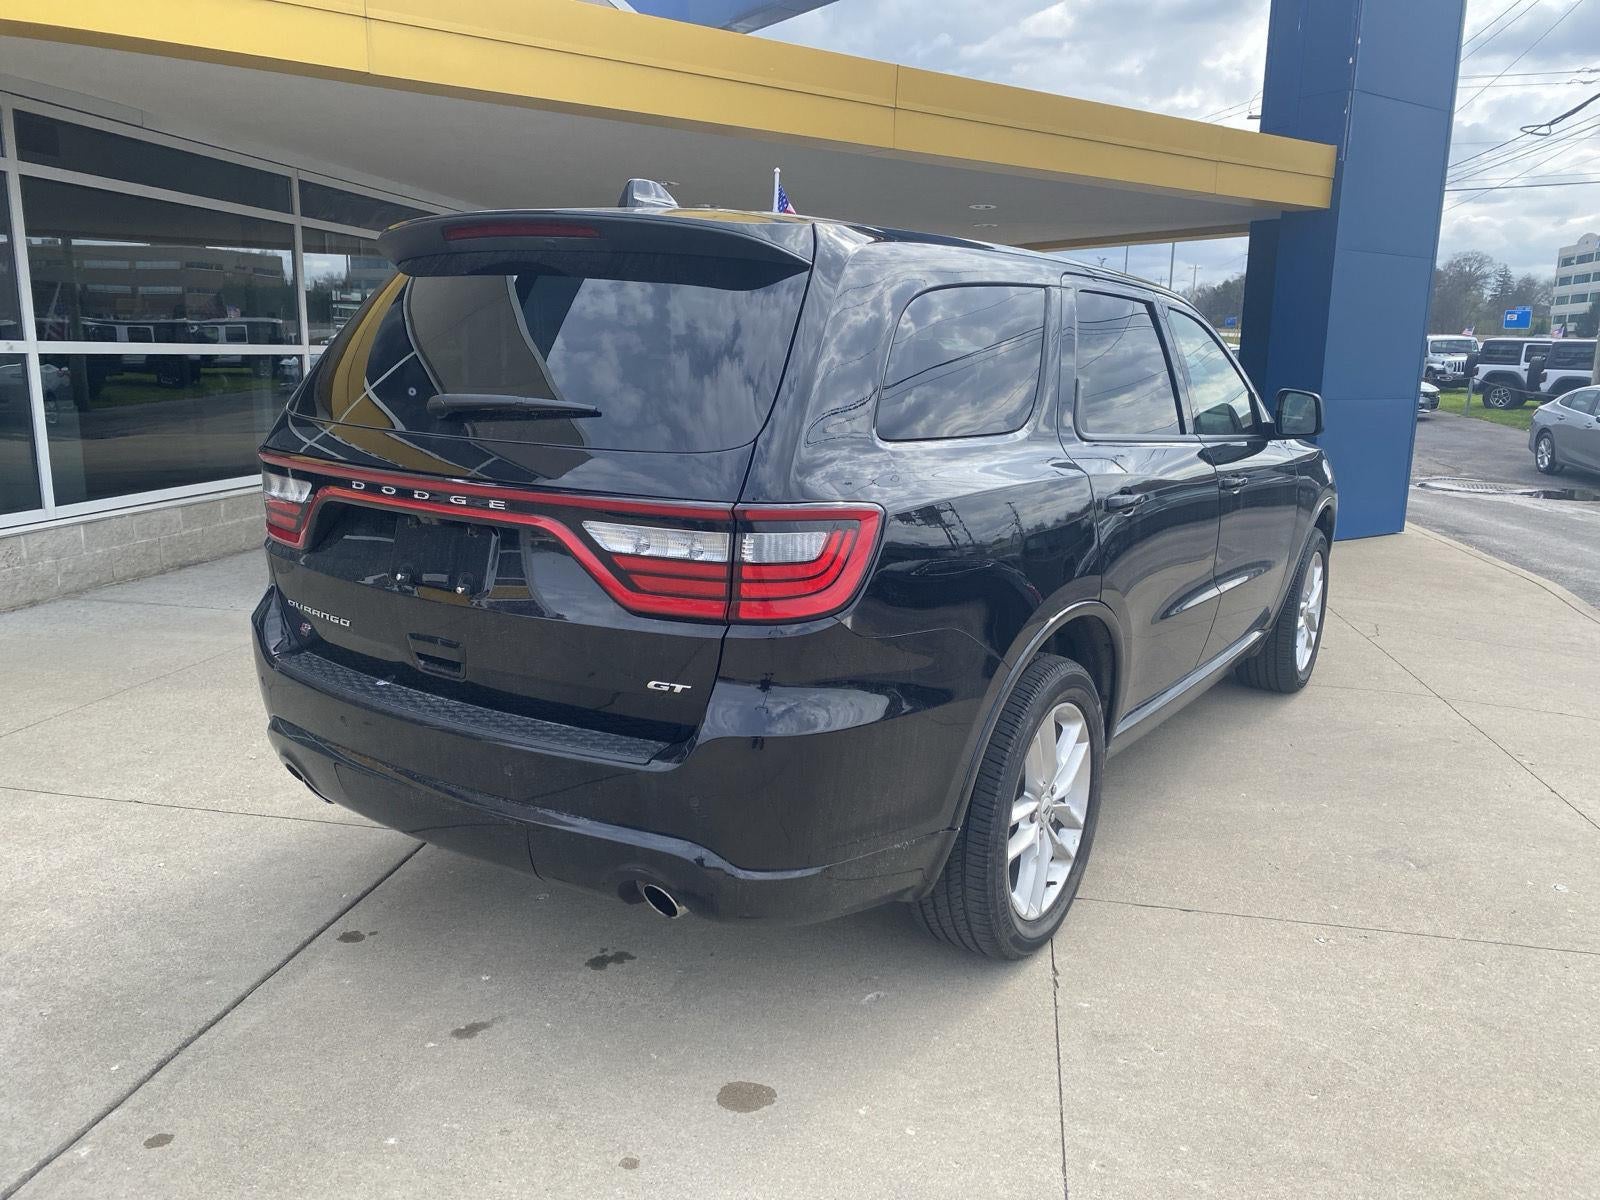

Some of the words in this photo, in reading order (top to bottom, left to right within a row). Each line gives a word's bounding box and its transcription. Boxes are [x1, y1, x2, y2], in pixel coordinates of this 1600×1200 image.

[351, 480, 506, 510] DODGE
[287, 599, 350, 627] DURANGO
[646, 680, 692, 693] GT
